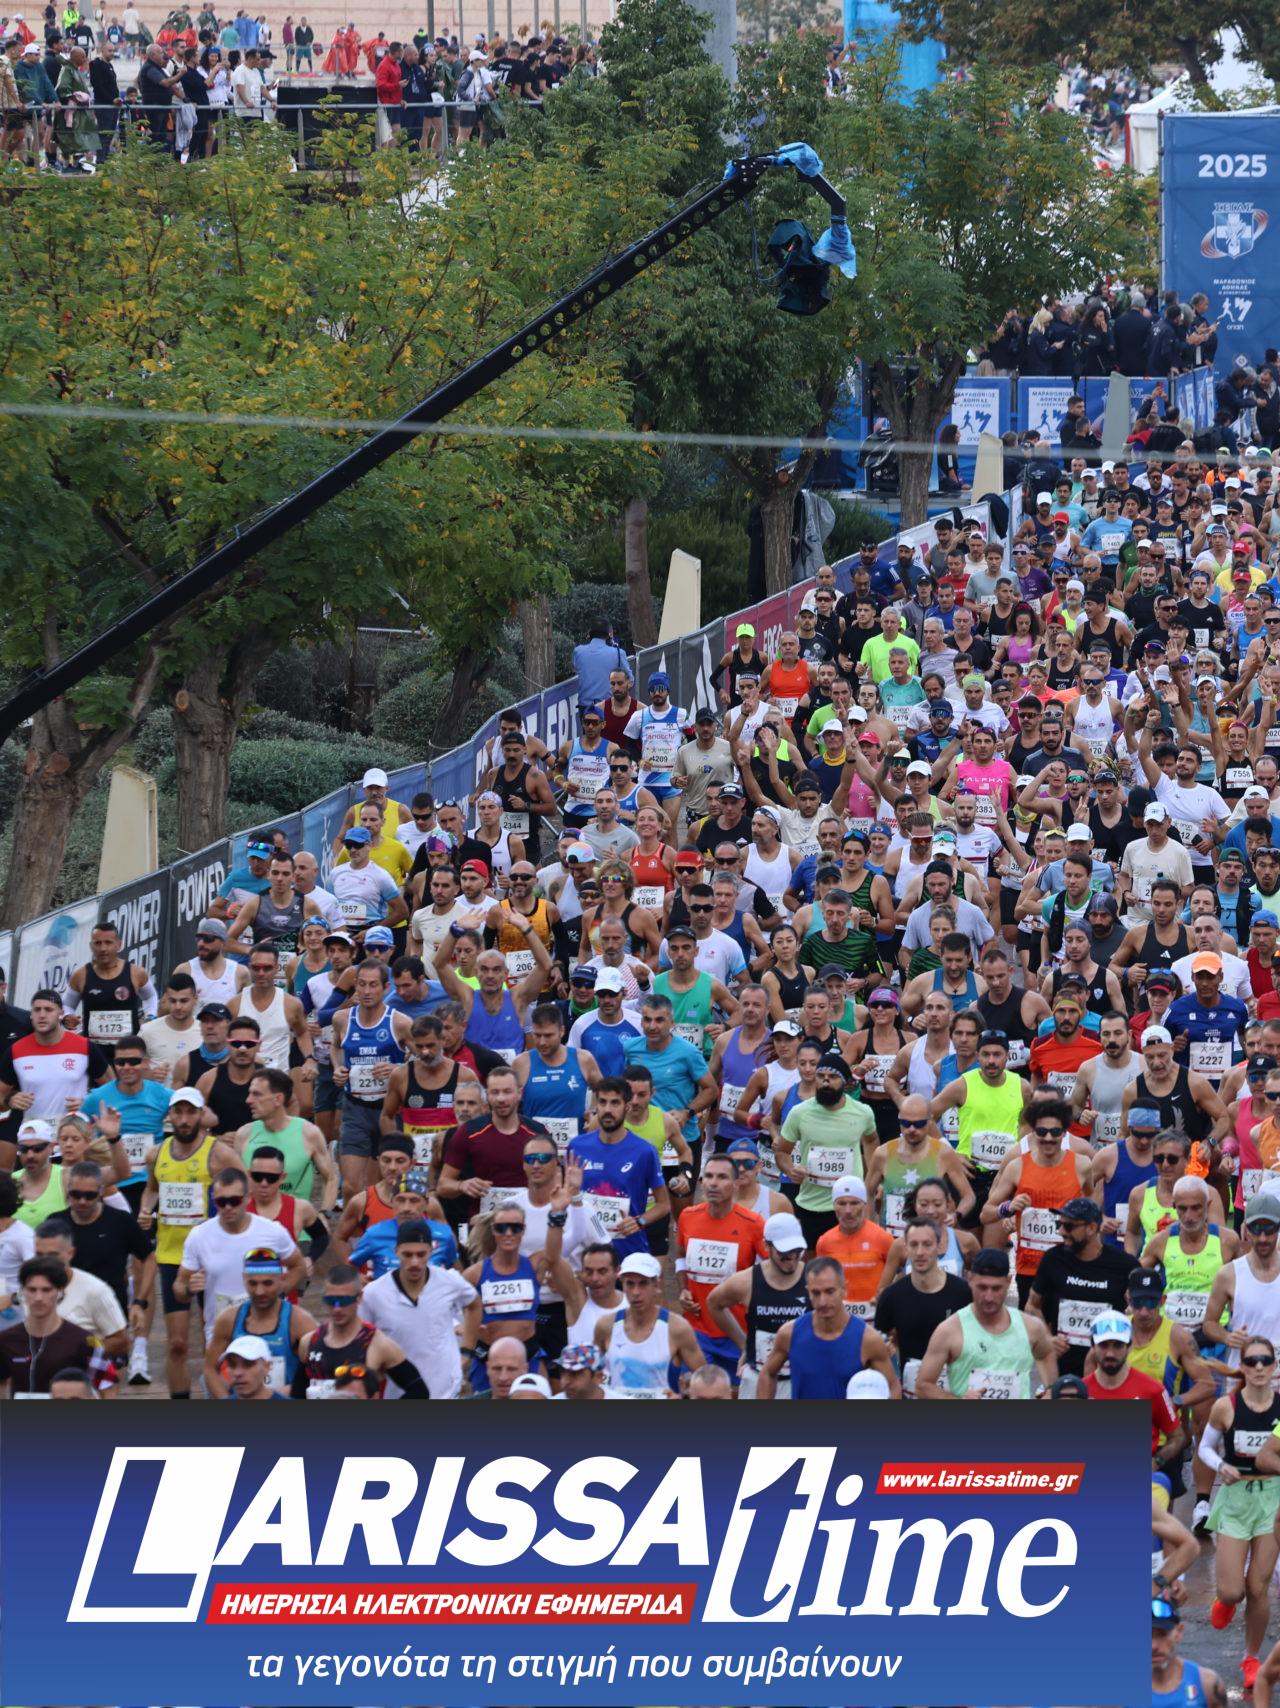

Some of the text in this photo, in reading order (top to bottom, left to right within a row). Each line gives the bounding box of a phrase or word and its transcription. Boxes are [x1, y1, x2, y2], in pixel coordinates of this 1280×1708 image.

[1198, 153, 1268, 178] 2025
[98, 1023, 123, 1034] 1173
[1198, 1055, 1224, 1066] 2227
[980, 1144, 1006, 1156] 1406
[817, 1161, 844, 1173] 1989
[166, 1198, 193, 1210] 2029
[697, 1256, 726, 1269] 1127
[492, 1282, 523, 1296] 2261
[756, 1304, 807, 1317] RUNAWAY
[1175, 1306, 1204, 1319] 4197
